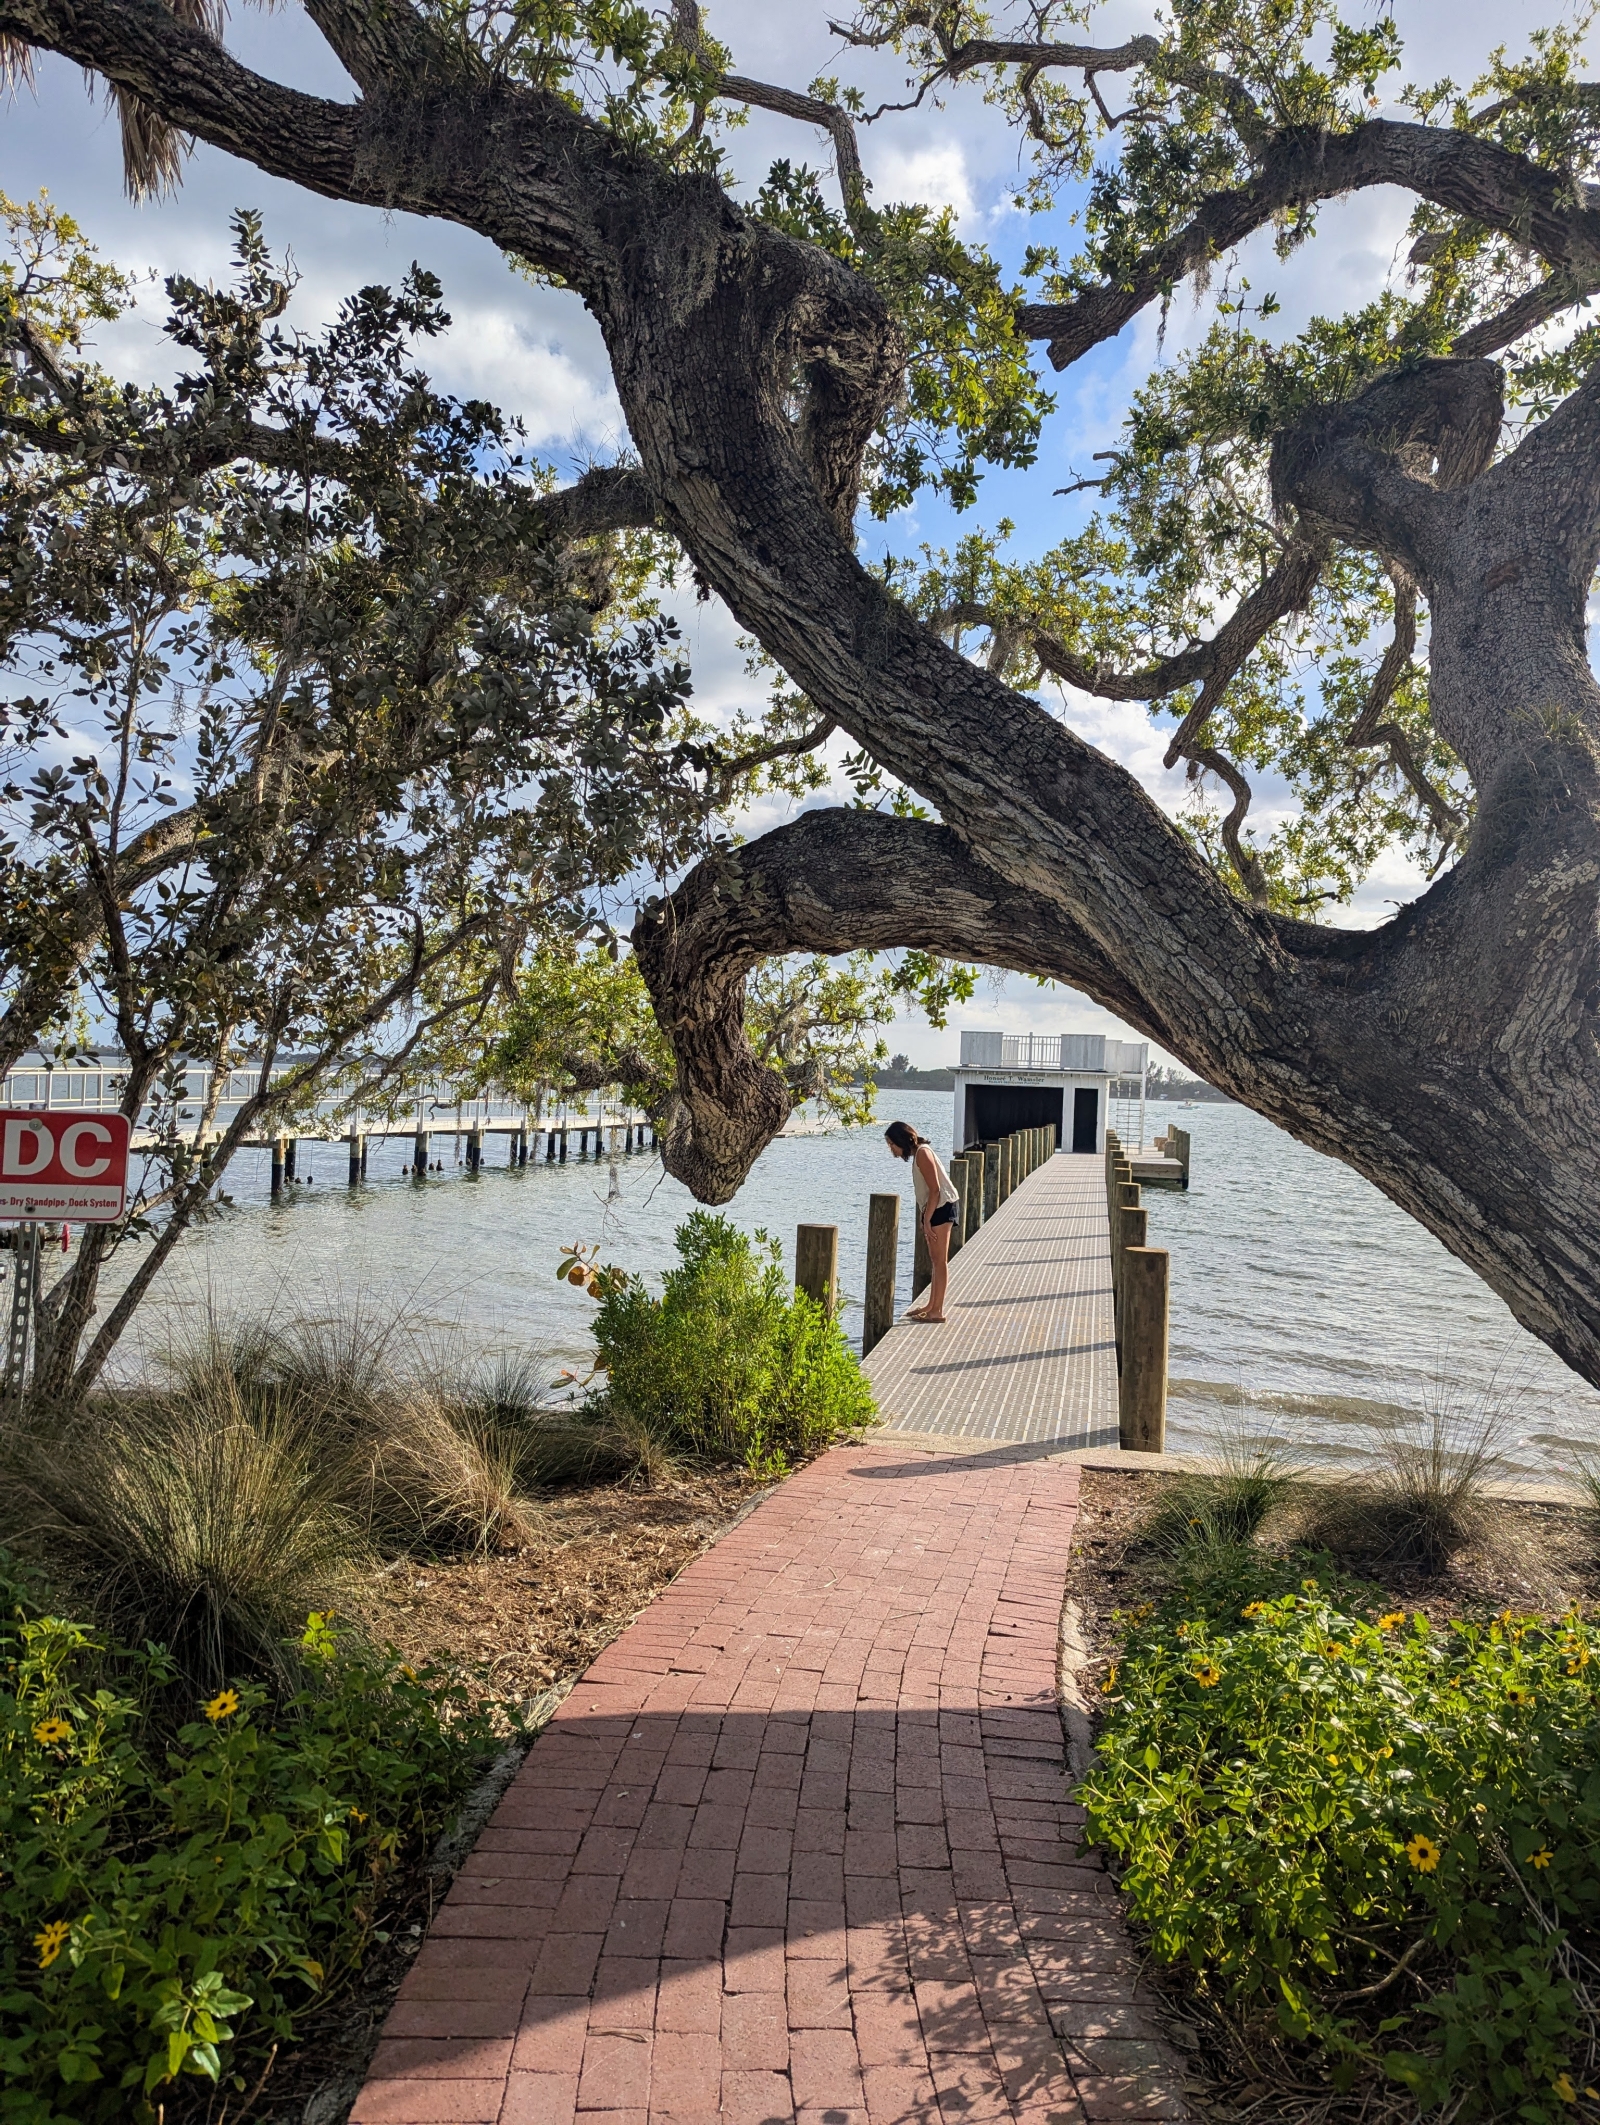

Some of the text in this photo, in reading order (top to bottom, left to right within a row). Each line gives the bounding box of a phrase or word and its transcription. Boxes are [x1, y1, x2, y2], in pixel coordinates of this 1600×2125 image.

[10, 1197, 24, 1207] Dry
[69, 1198, 88, 1207] Dock
[90, 1199, 117, 1208] System
